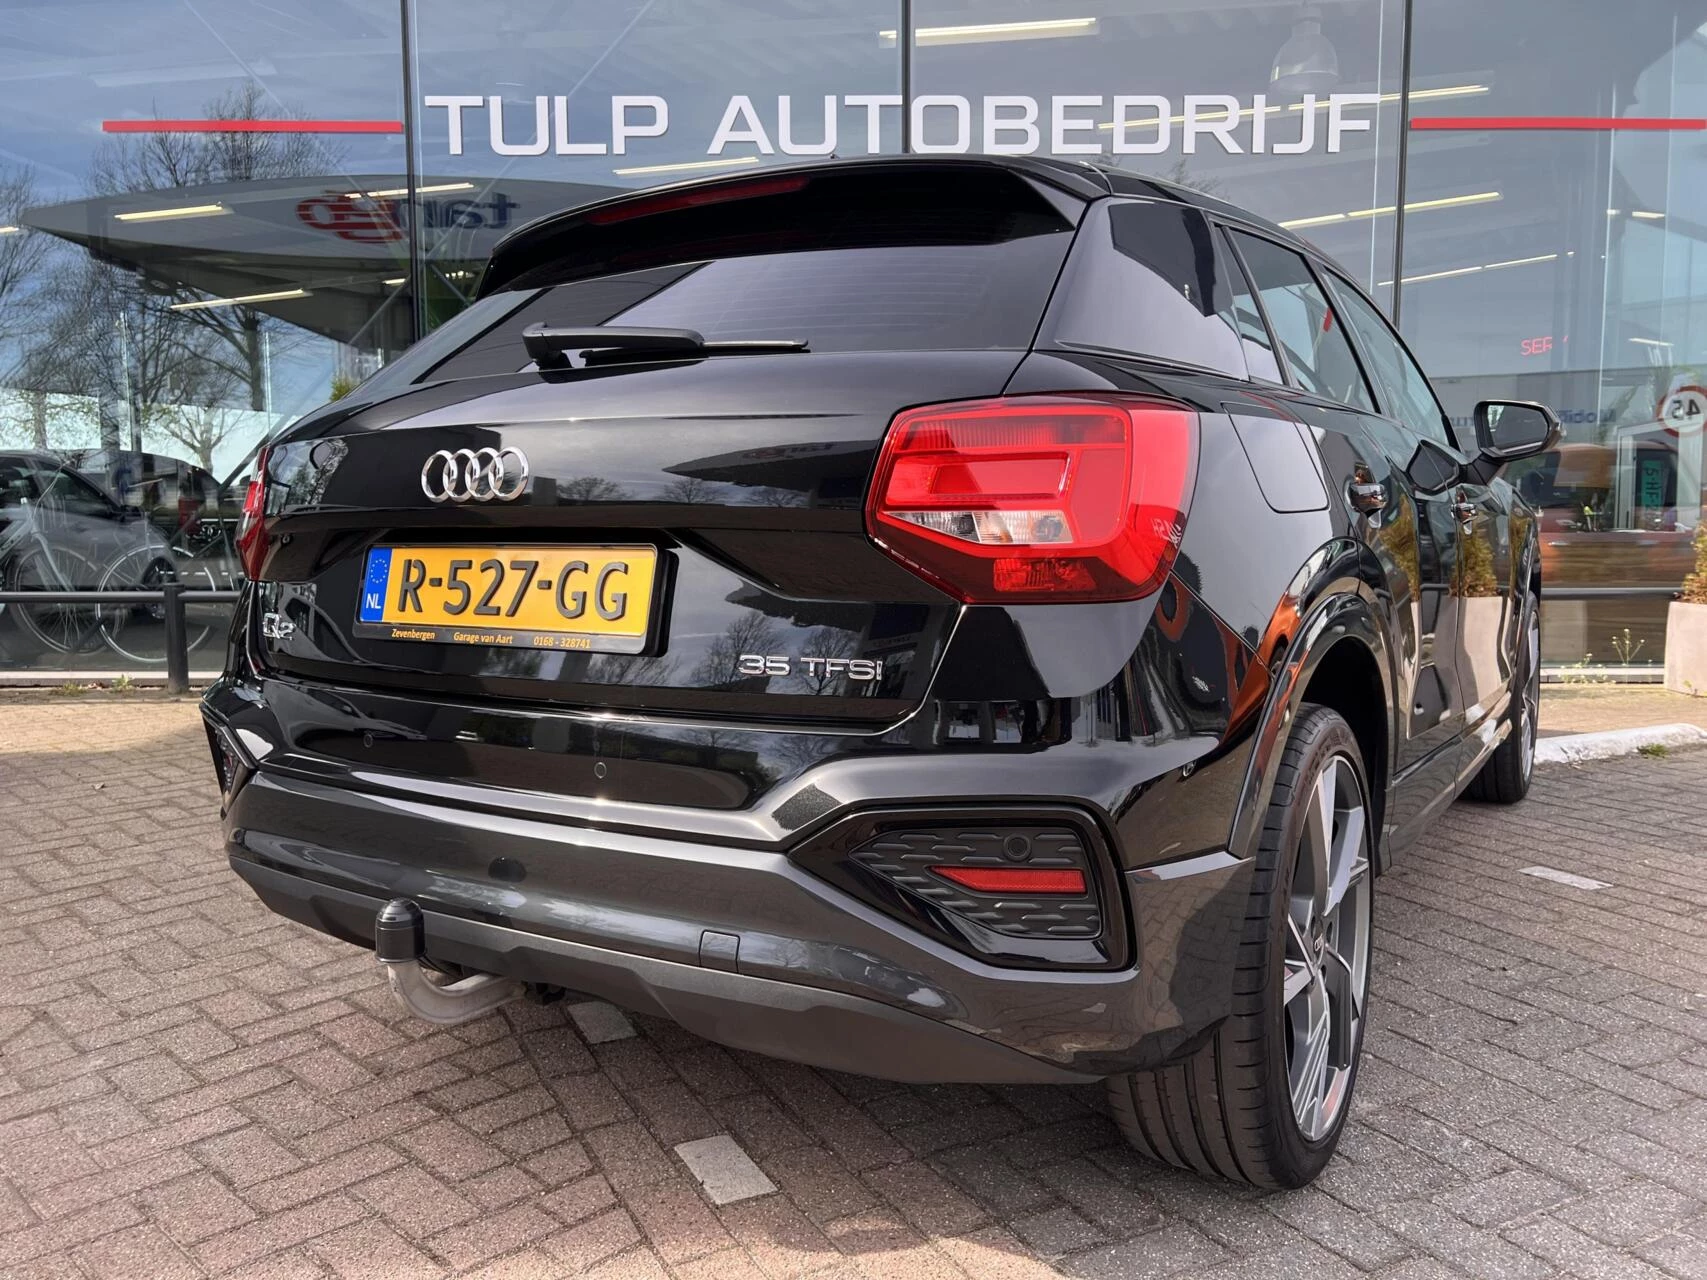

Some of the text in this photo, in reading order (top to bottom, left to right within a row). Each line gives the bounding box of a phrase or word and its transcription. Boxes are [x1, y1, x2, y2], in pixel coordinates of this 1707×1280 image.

[425, 94, 1380, 155] TULP AUTOBEDRIJF
[397, 559, 629, 621] R-527-GG
[366, 593, 381, 609] NL
[262, 612, 297, 640] Q2
[391, 628, 436, 641] Zevenbergen
[453, 631, 513, 645] Garage van Aart
[533, 636, 553, 647] 0168
[560, 637, 592, 649] 328741
[738, 654, 883, 681] 35 TFSI
